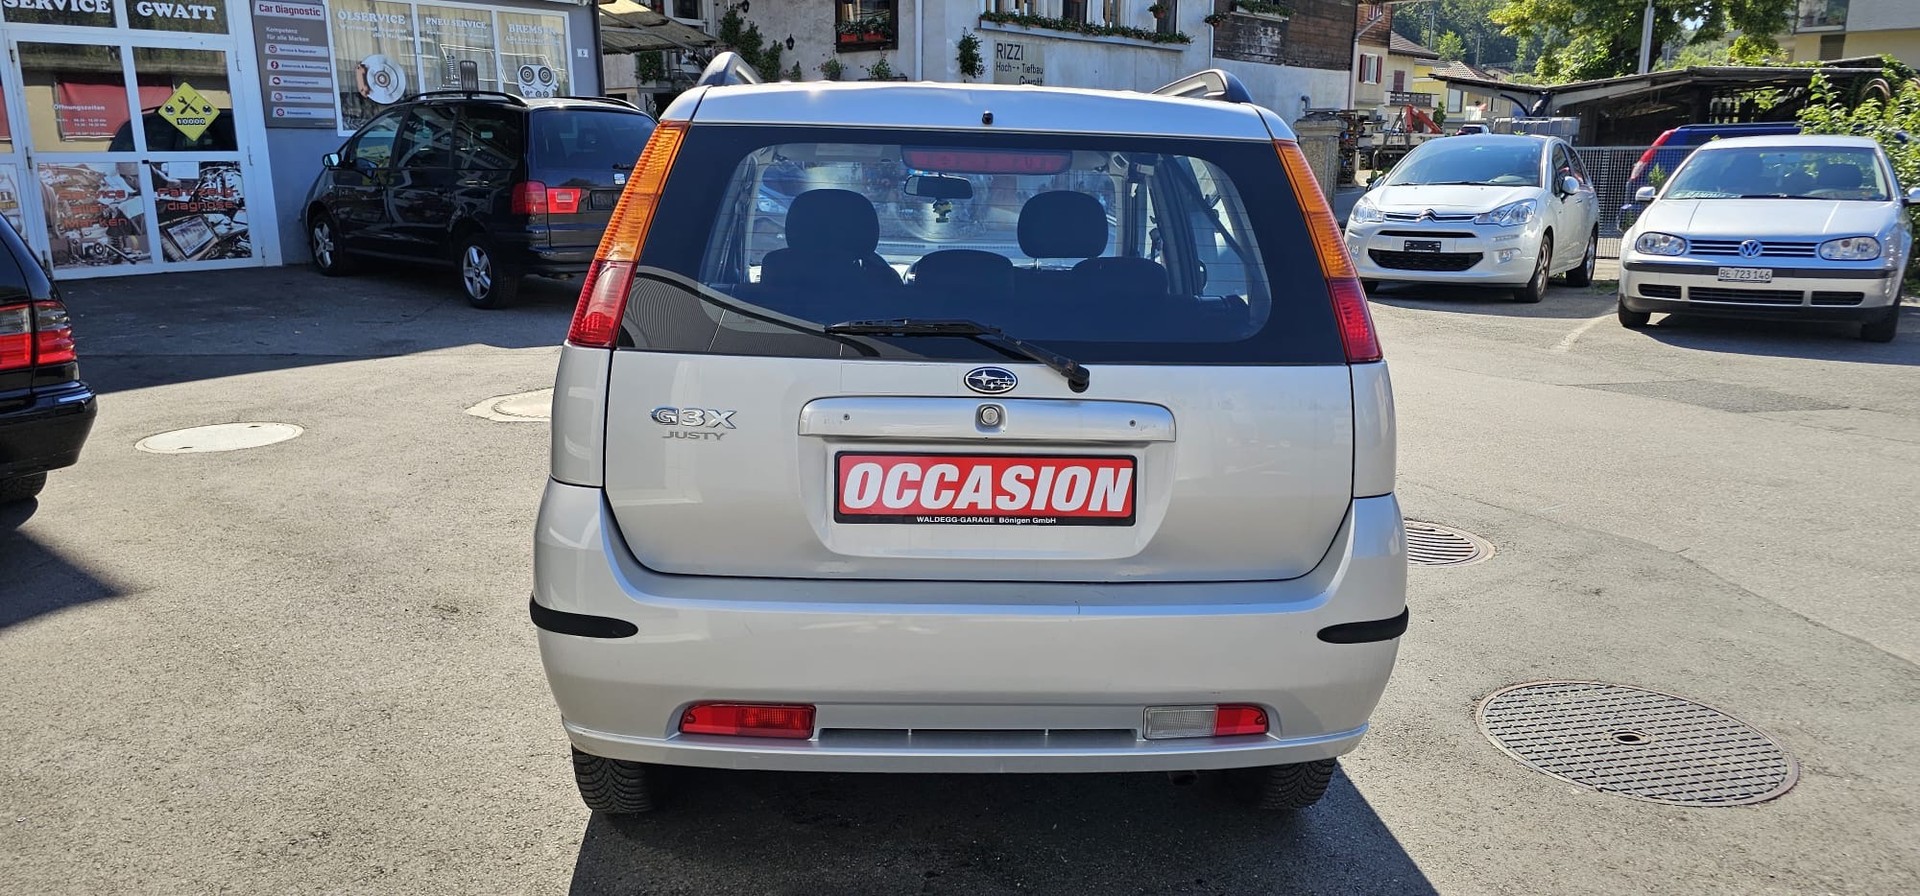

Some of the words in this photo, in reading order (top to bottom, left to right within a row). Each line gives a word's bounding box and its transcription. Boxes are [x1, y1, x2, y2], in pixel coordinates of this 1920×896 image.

[136, 1, 217, 20] GWATT
[259, 4, 273, 13] Car
[275, 5, 321, 17] Diagnostic
[451, 19, 488, 30] SERVICE
[996, 43, 1023, 60] RIZZI
[1022, 63, 1044, 75] Tiefbau
[167, 201, 234, 212] diagnose
[1720, 269, 1731, 278] BE
[1735, 269, 1751, 279] 723
[1753, 270, 1770, 280] 146
[650, 407, 738, 430] G3X
[662, 431, 725, 440] JUSTY
[843, 461, 1133, 513] OCCASION
[998, 516, 1031, 525] Bönigen
